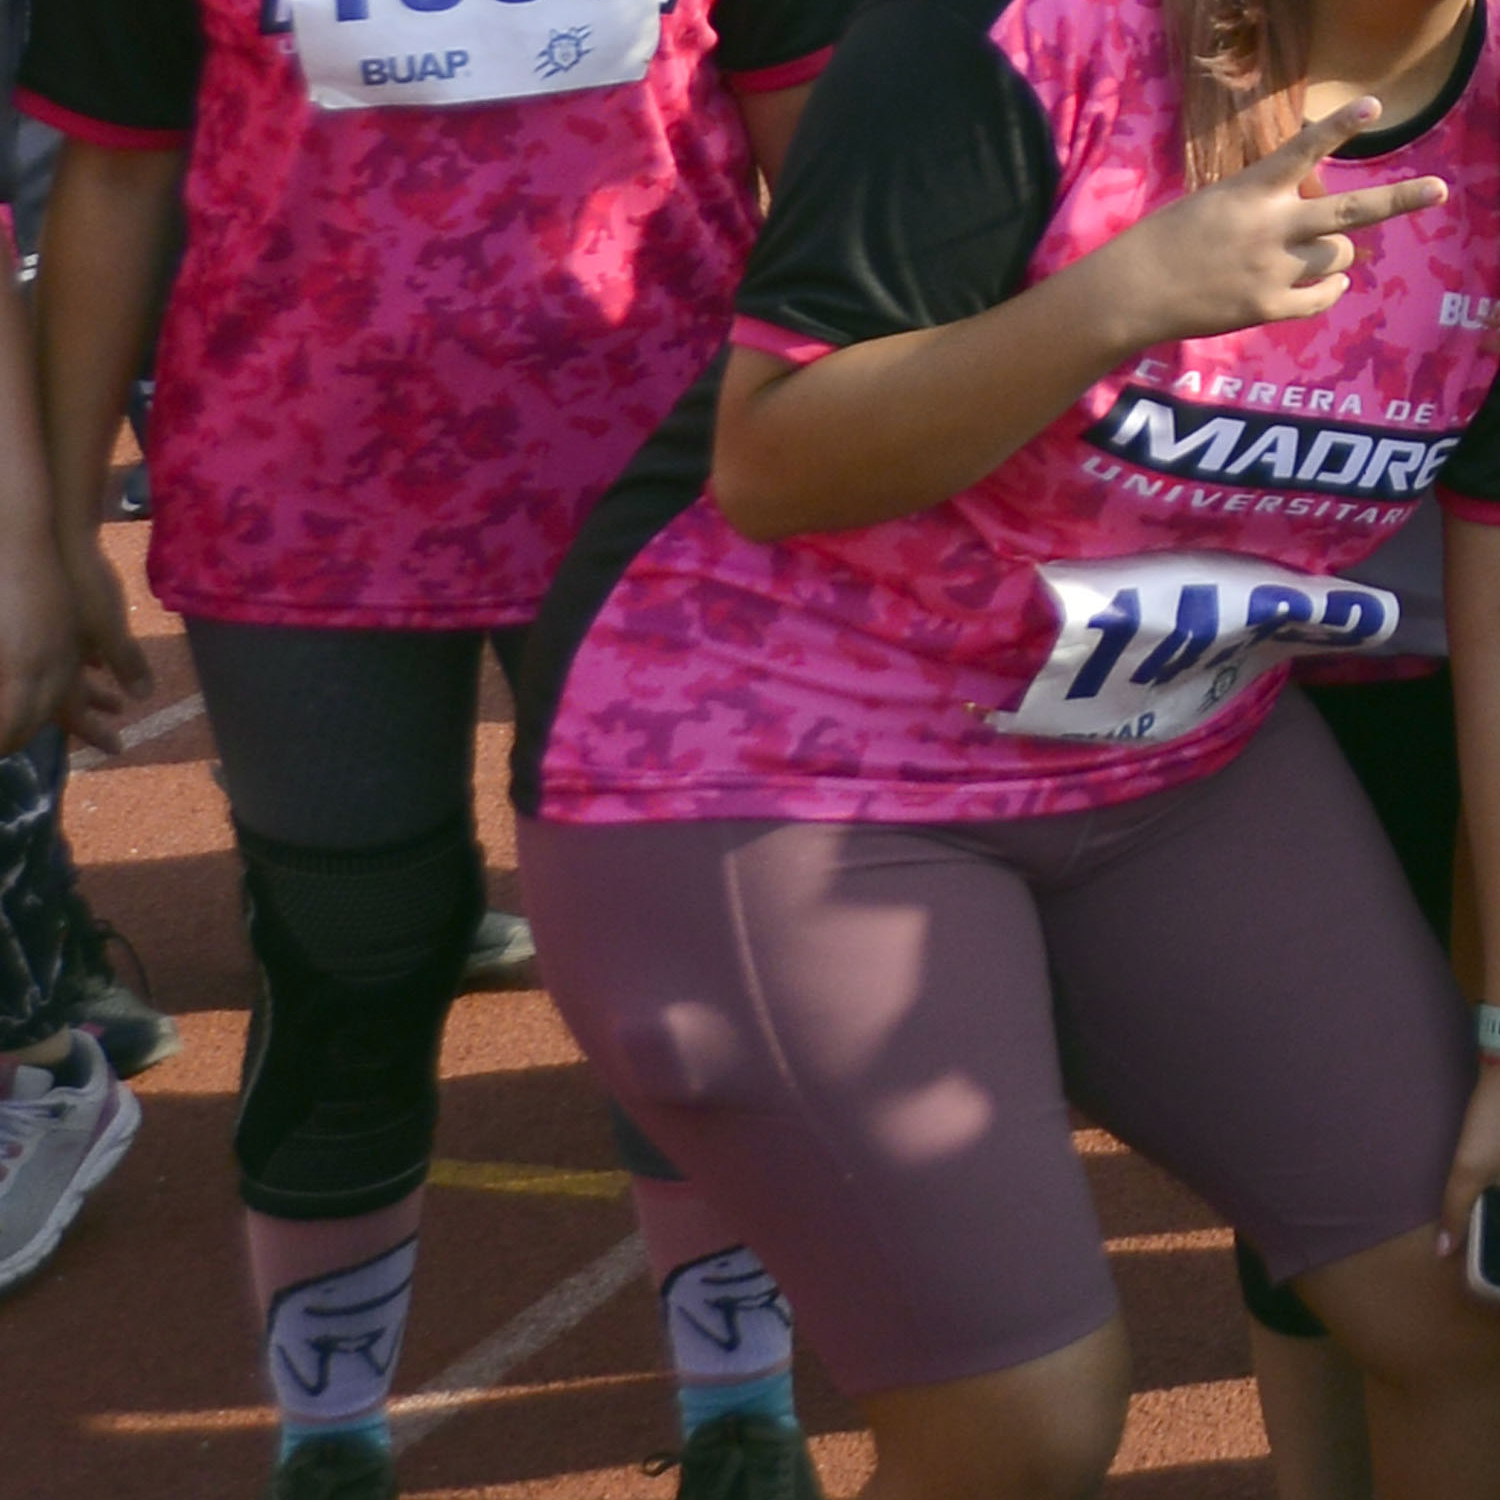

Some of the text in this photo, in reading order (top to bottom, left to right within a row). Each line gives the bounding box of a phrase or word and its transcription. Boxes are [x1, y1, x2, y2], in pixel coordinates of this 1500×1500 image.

[361, 48, 469, 87] BUAP
[1134, 357, 1364, 417] CARRERA
[1384, 398, 1435, 426] DE
[1112, 398, 1462, 492] MADRE
